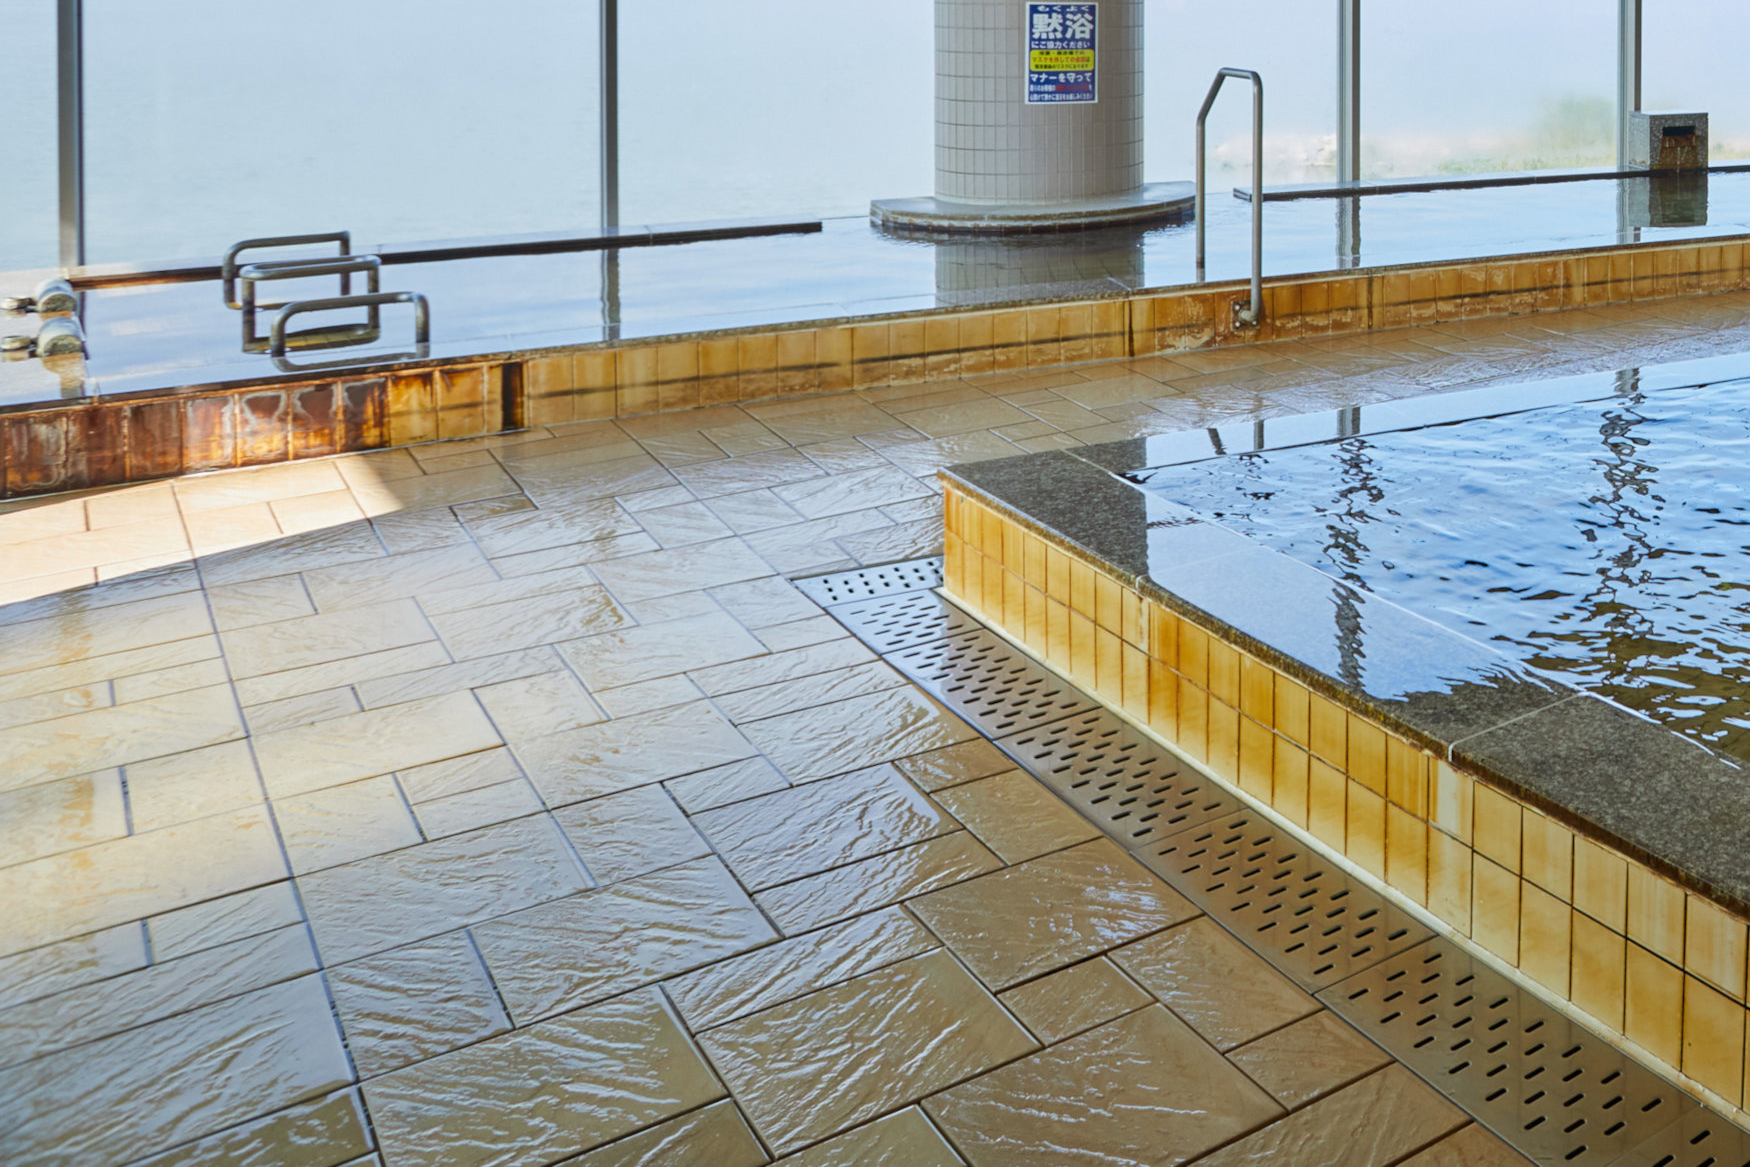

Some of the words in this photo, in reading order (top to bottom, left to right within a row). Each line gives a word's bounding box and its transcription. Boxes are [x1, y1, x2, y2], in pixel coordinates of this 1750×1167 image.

[1032, 12, 1094, 40] 黙浴
[1031, 41, 1090, 49] にご協力ください
[1030, 72, 1092, 83] マナーを守って
